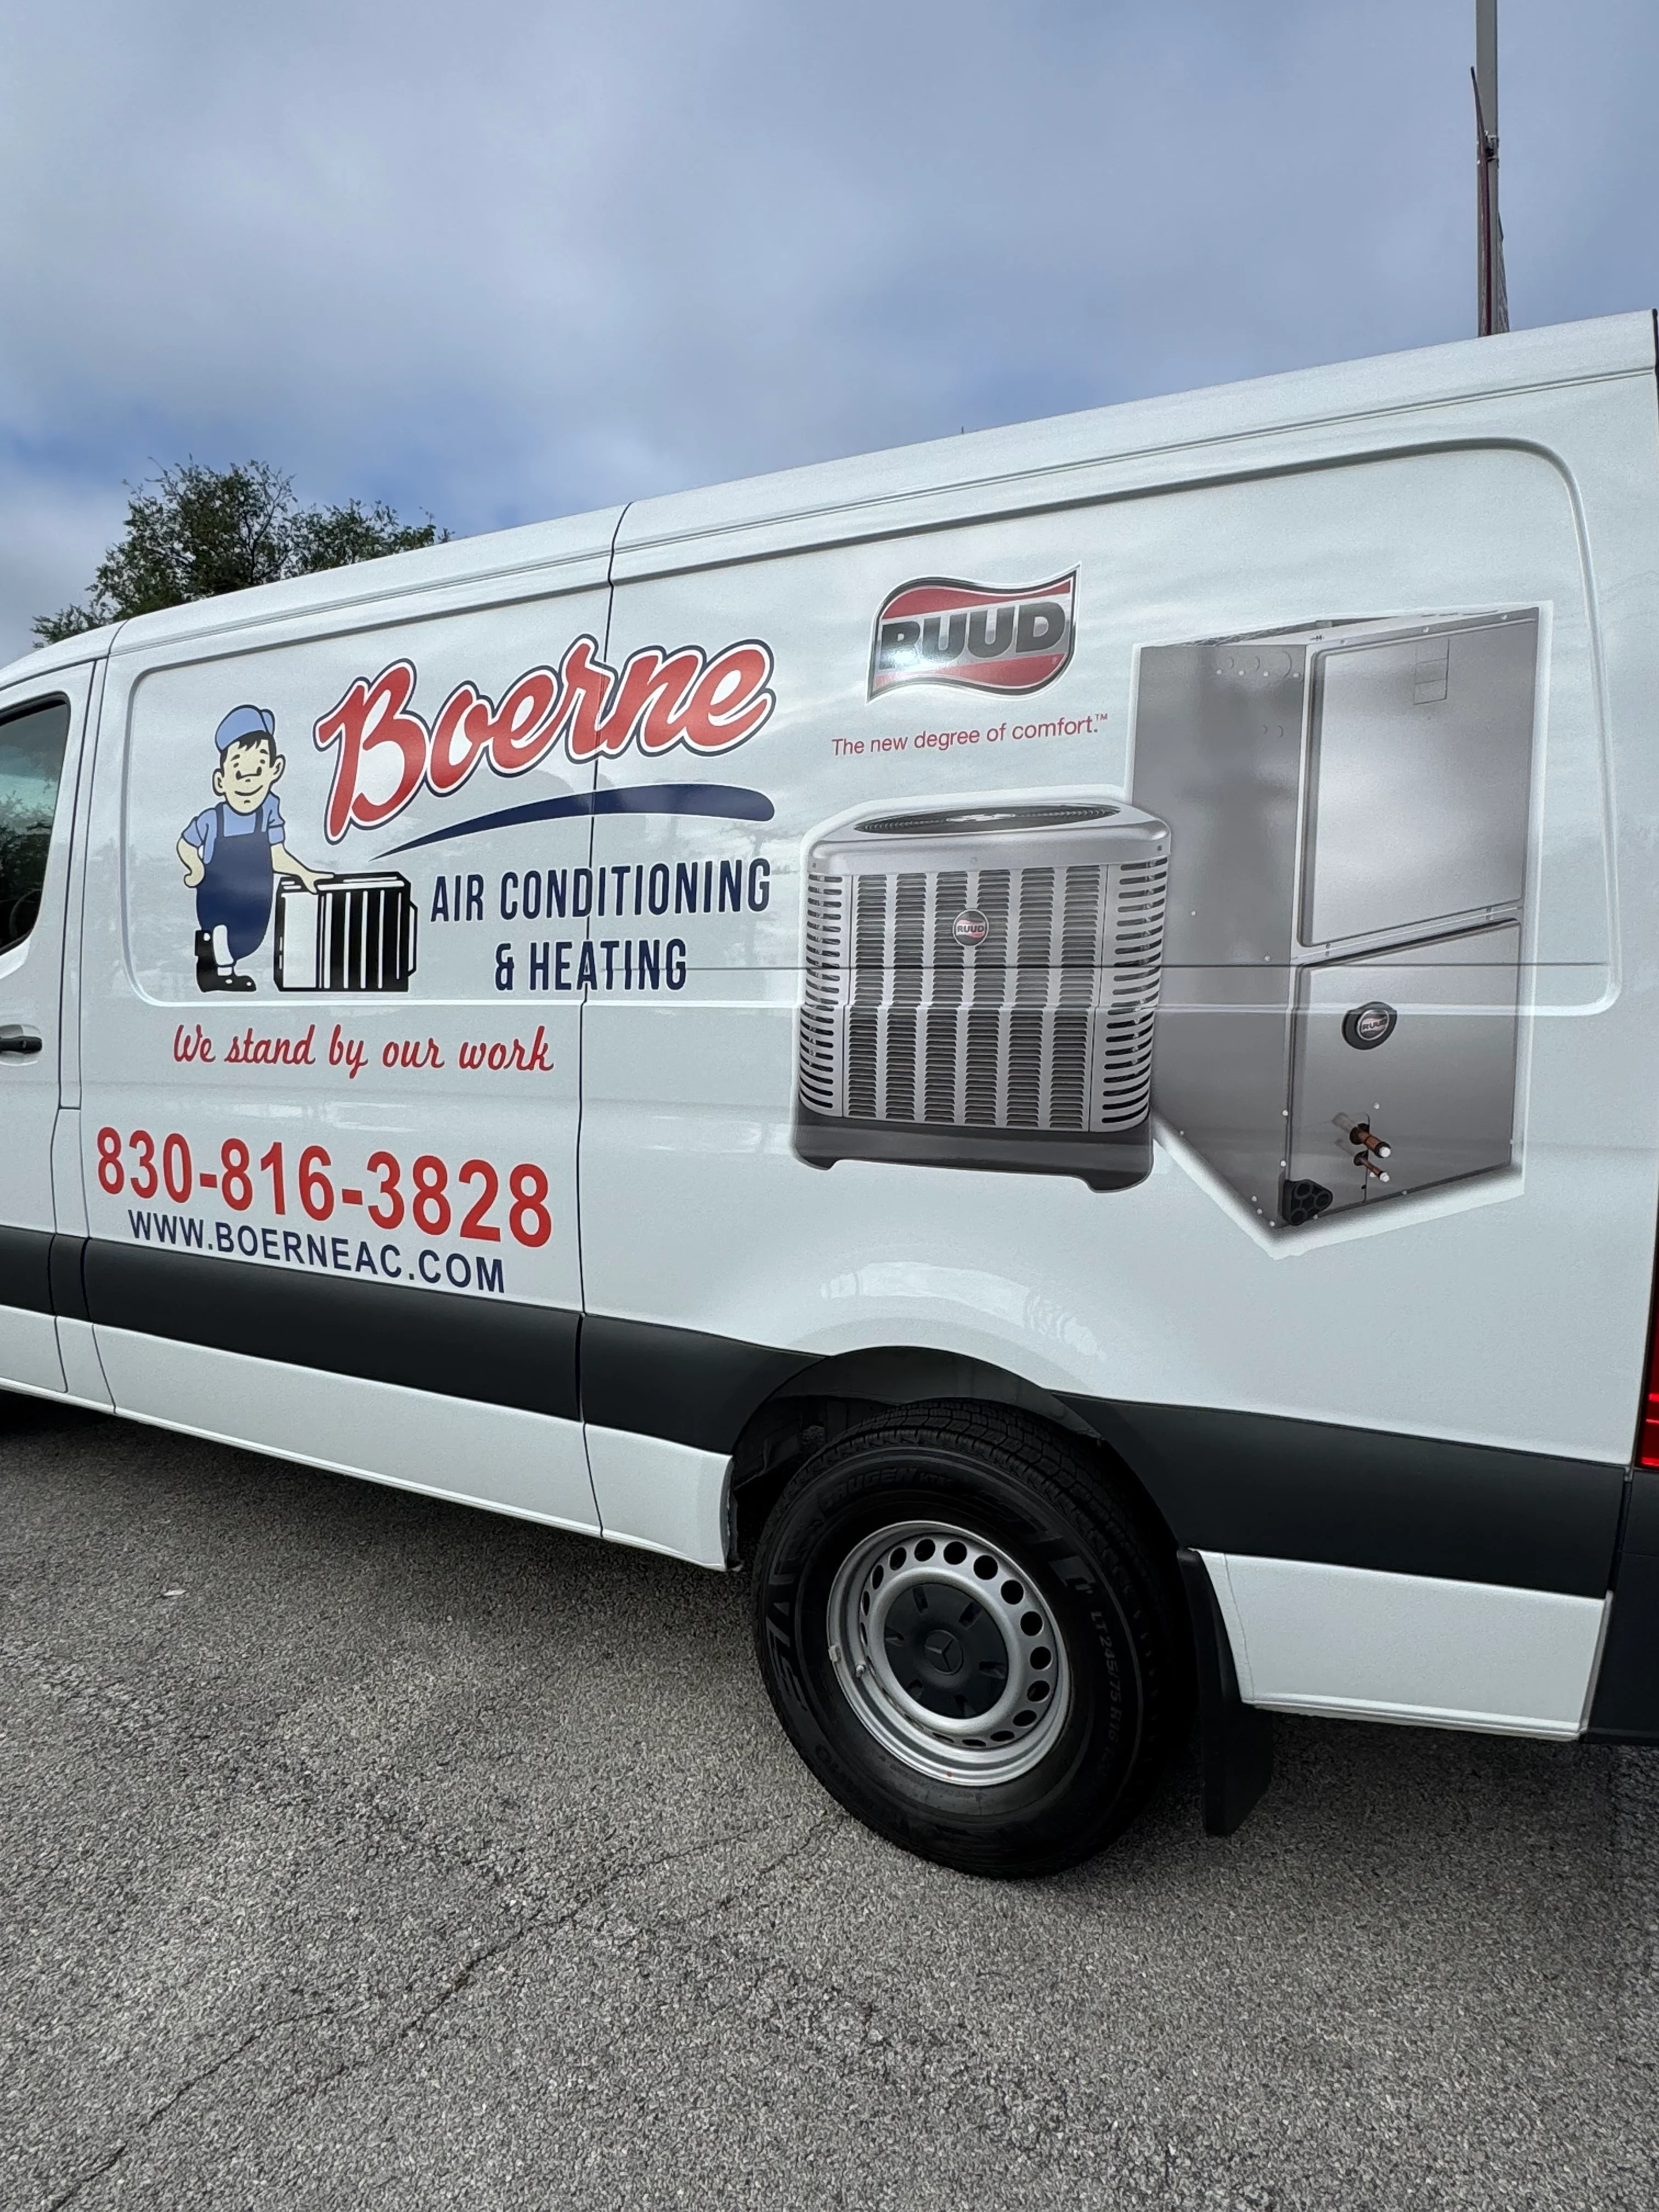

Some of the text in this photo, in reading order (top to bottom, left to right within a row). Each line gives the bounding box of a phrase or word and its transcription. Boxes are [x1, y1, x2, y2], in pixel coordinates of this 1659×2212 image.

[879, 601, 1066, 670] RUUD
[314, 634, 776, 845] Boerne
[831, 737, 865, 756] The
[870, 734, 908, 753] new
[914, 729, 980, 751] degree
[986, 723, 1007, 742] of
[431, 858, 770, 922] AIR CONDITIONING
[956, 924, 985, 933] RUUD
[495, 938, 687, 991] & HEATING
[173, 1024, 554, 1079] We stand by our work
[97, 1126, 552, 1248] 830-816-3828
[128, 1209, 505, 1293] WWW.BOERNEAC.COM
